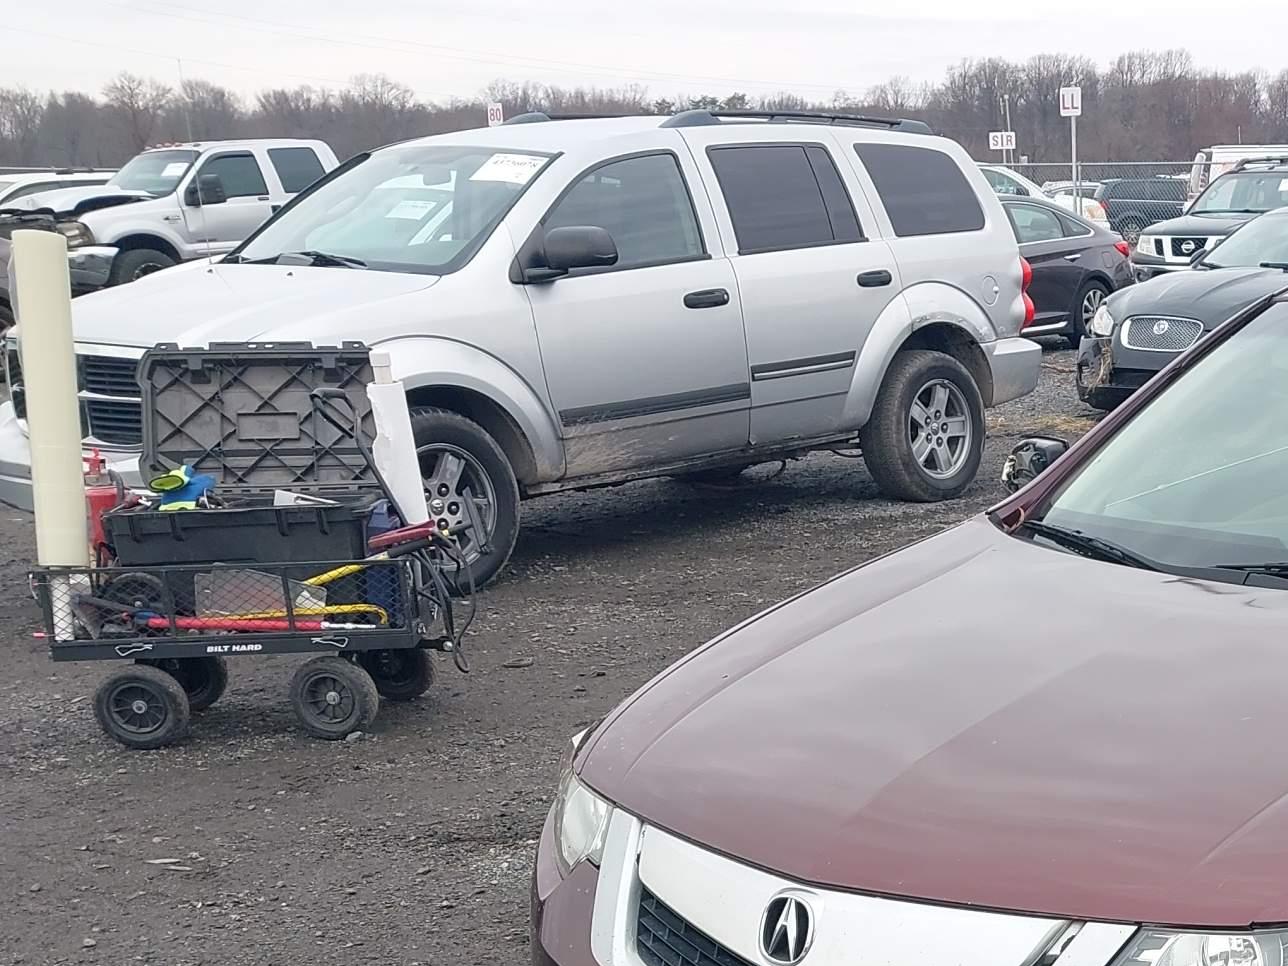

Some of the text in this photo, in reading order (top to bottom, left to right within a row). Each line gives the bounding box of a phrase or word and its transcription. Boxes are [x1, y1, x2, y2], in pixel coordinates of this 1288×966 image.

[1062, 93, 1079, 110] LL
[489, 107, 501, 122] 80
[206, 643, 262, 653] BILT HARD
